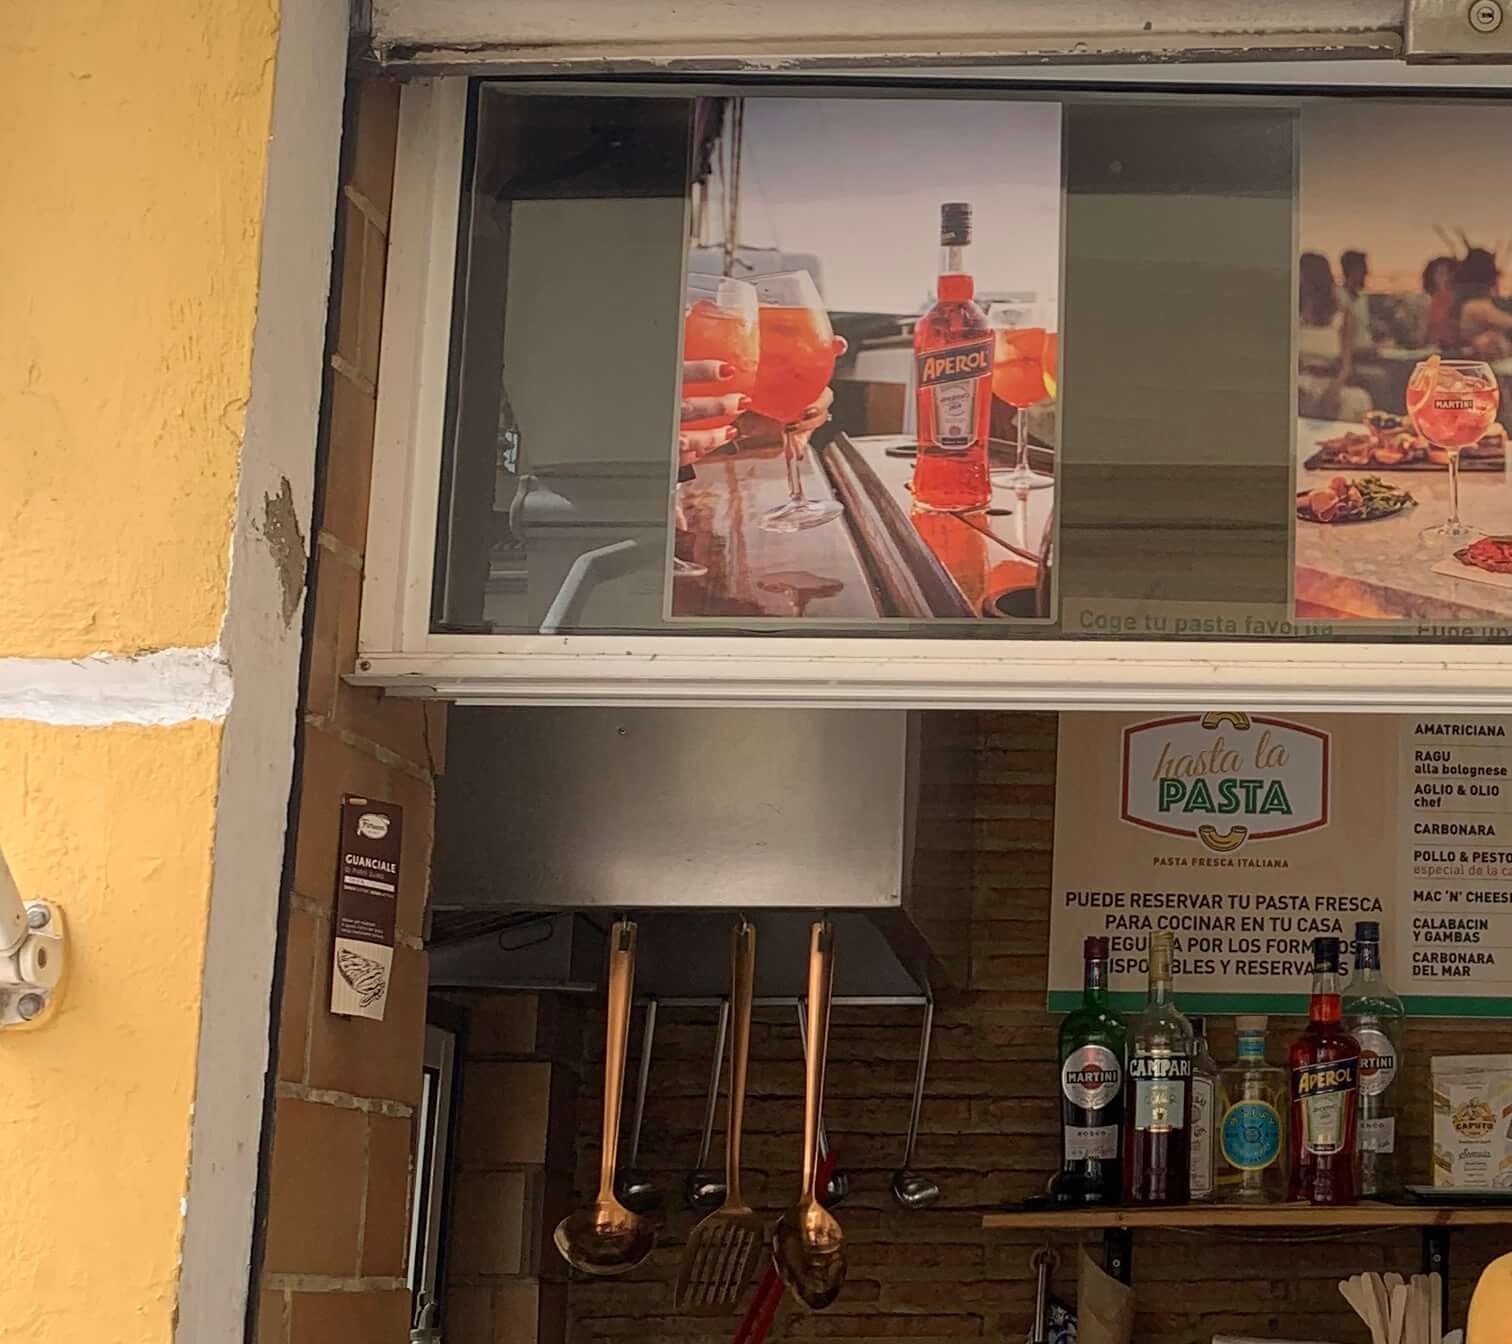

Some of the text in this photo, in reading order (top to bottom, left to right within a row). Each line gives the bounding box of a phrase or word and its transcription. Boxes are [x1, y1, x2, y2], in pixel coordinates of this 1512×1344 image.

[922, 351, 988, 382] APEROL
[1435, 399, 1474, 410] MARTINI
[1079, 609, 1236, 636] Coge tu pasta
[1415, 724, 1505, 737] AMATRICIANA
[1152, 730, 1290, 780] hasta la
[1415, 750, 1451, 762] RAGU
[1414, 763, 1508, 778] alla bolognese
[1158, 777, 1292, 815] PASTA
[1414, 784, 1500, 797] AGLIO & OLIO
[1414, 796, 1441, 808] chef
[1413, 823, 1495, 836] CARBONARA
[1153, 857, 1289, 868] PASTA FRESCA ITALIANA
[1413, 851, 1455, 863] POLLO
[1459, 851, 1469, 863] &
[345, 854, 397, 874] GUANCIALE
[1413, 863, 1463, 877] especial
[1468, 863, 1482, 876] de
[1487, 864, 1497, 876] la
[1065, 892, 1383, 912] PUEDE RESERVAR TU PASTA FRESCA
[1413, 891, 1439, 903] MAC
[1105, 915, 1343, 933] PARA COCINAR EN TU CASA
[1413, 918, 1488, 931] CALABACIN
[1413, 931, 1481, 943] Y GAMBAS
[1188, 938, 1357, 955] POR LOS FORMOS
[1412, 952, 1495, 965] CARBONARA
[1220, 960, 1230, 975] Y
[1412, 964, 1471, 977] DEL MAR
[1129, 1059, 1191, 1077] CAMPARI
[1360, 1056, 1393, 1069] RTINI
[1067, 1071, 1117, 1084] MARTINI
[1298, 1068, 1353, 1093] APEROL
